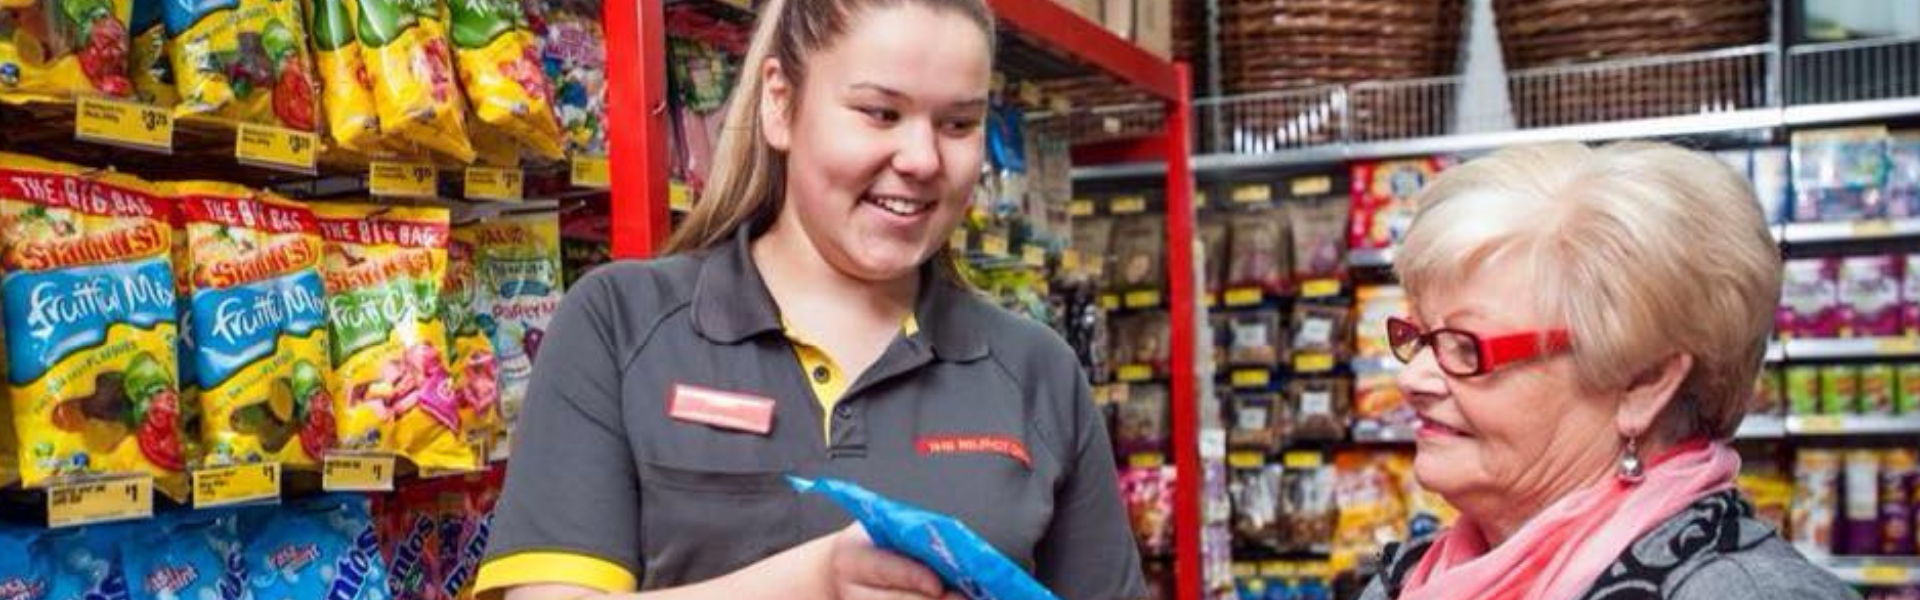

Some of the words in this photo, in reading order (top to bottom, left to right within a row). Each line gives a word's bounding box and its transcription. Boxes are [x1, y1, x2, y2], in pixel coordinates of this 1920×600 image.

[12, 176, 60, 204] THE
[63, 178, 108, 214] BIG
[203, 199, 238, 224] THE
[320, 221, 356, 241] THE
[358, 220, 395, 244] BIG
